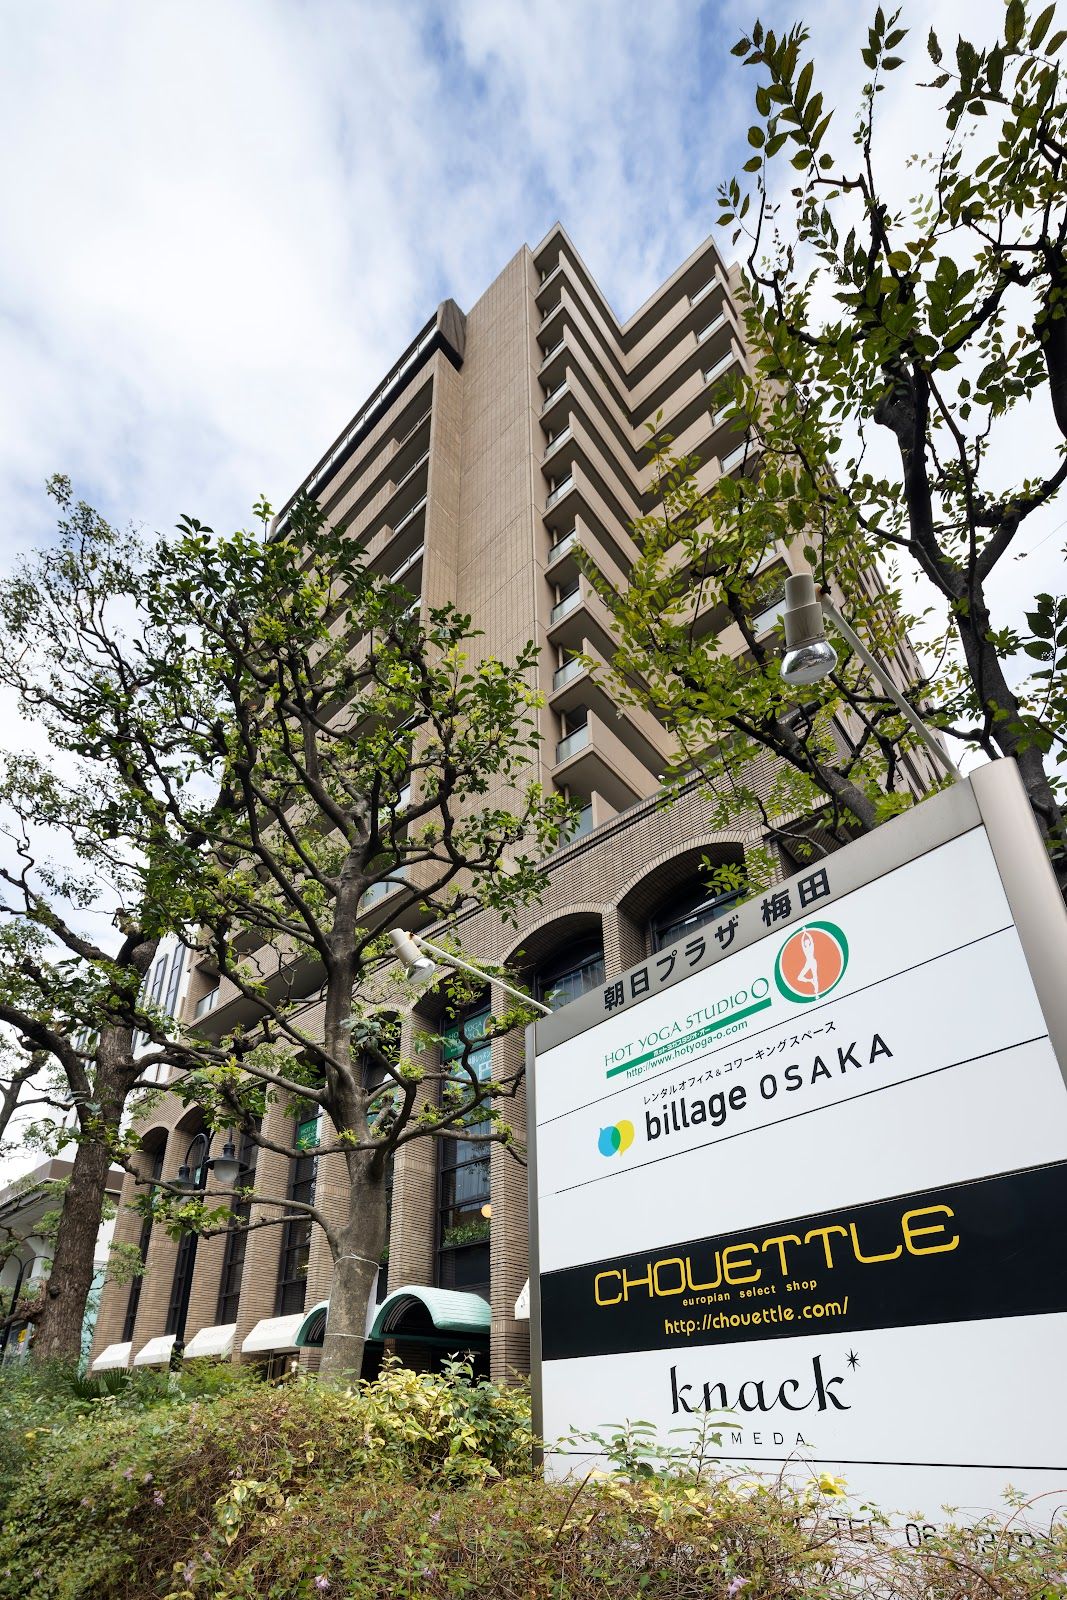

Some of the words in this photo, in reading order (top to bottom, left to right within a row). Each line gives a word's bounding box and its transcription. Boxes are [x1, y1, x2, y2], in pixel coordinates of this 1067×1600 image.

[604, 915, 740, 1011] 朝日プラザ
[761, 868, 831, 926] 梅田
[604, 1042, 634, 1066] HOT
[638, 1021, 682, 1052] YOGA
[686, 990, 748, 1029] STUDIO
[626, 1019, 748, 1079] http://www.hotyoga-o.com
[646, 1085, 747, 1141] billage
[760, 1033, 893, 1100] OSAKA
[595, 1205, 960, 1306] CHOUETTLE
[664, 1296, 849, 1335] http://chouettle.com/
[682, 1292, 731, 1306] europian
[739, 1284, 777, 1299] select
[786, 1278, 818, 1292] shop
[670, 1354, 852, 1414] knack
[711, 1432, 806, 1445] MEDA
